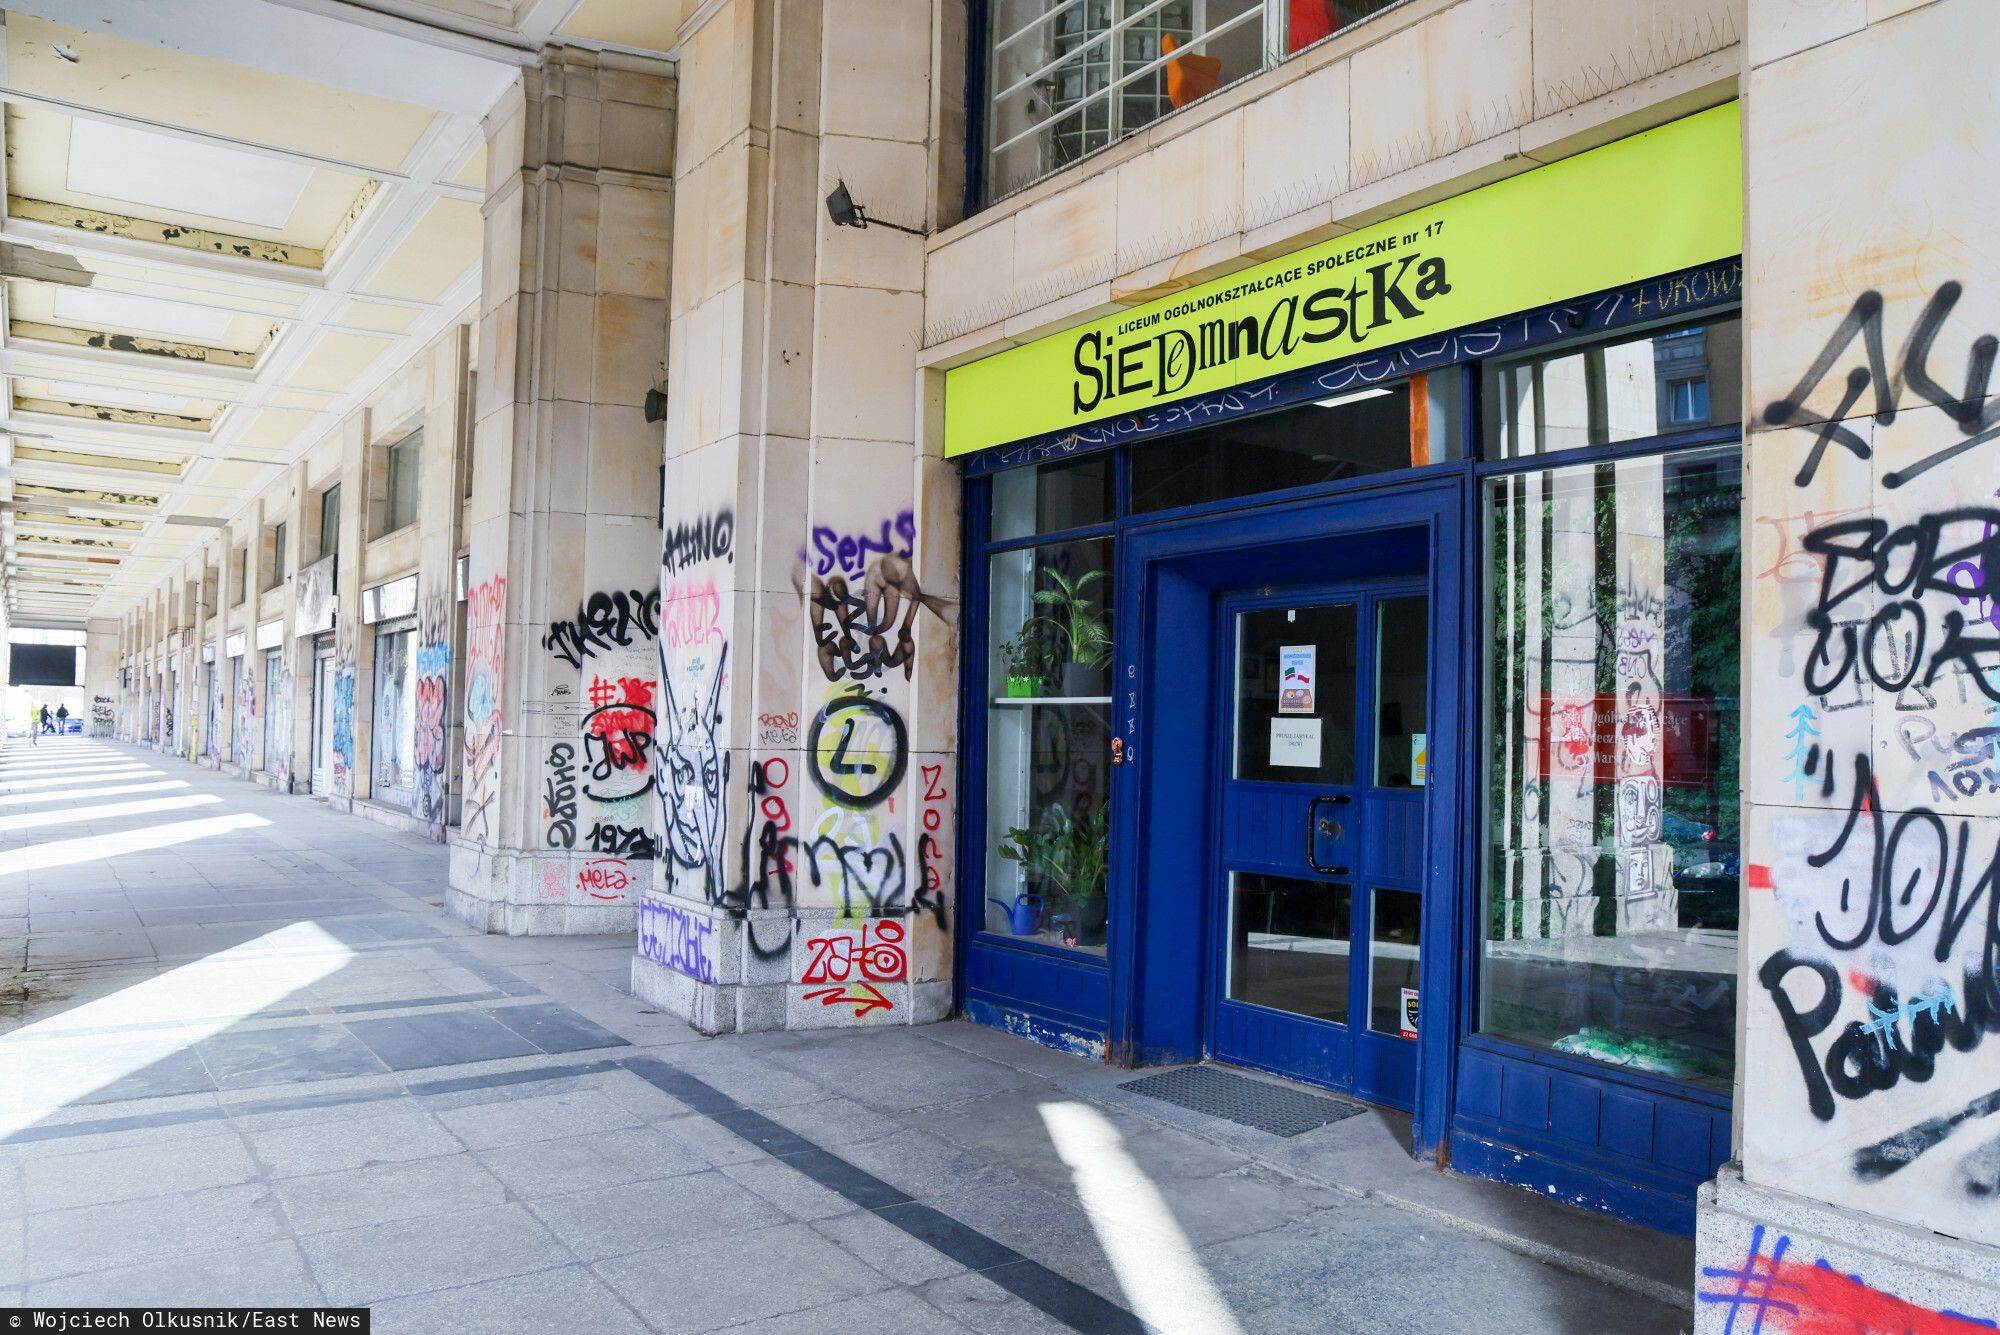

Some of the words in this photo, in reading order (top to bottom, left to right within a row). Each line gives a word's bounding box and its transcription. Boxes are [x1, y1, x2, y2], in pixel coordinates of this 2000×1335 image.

[1118, 312, 1161, 336] LICEUM
[1164, 267, 1303, 323] OGÓLNOKSZTAŁCĄCE
[1307, 236, 1398, 276] SPOŁECZNE
[1402, 231, 1420, 247] nr
[1425, 221, 1445, 240] 17
